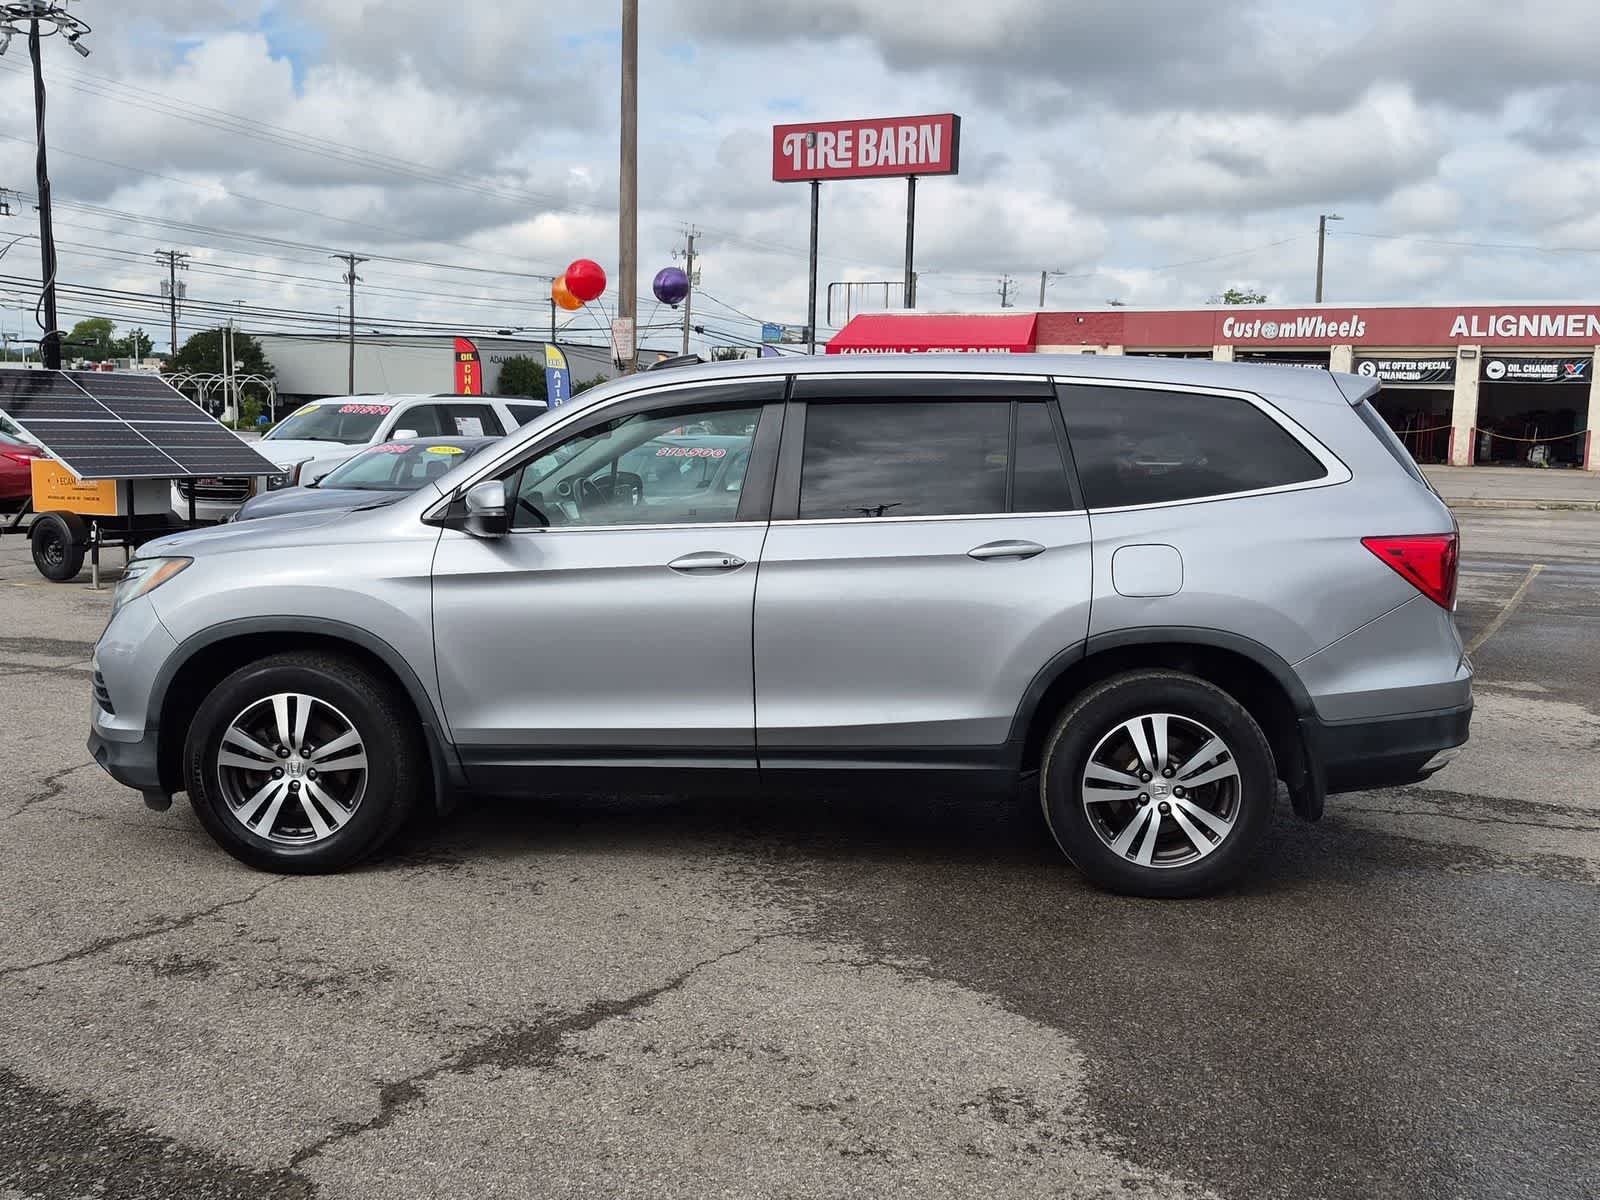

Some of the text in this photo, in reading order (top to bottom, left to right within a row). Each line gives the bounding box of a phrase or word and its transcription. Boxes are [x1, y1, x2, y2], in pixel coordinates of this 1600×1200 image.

[783, 124, 942, 171] TIRE BARN
[460, 353, 473, 361] OIL
[1379, 361, 1451, 370] WE OFFER SPECIAL
[1507, 363, 1558, 373] OIL CHANGE
[1377, 371, 1420, 380] FINANCING
